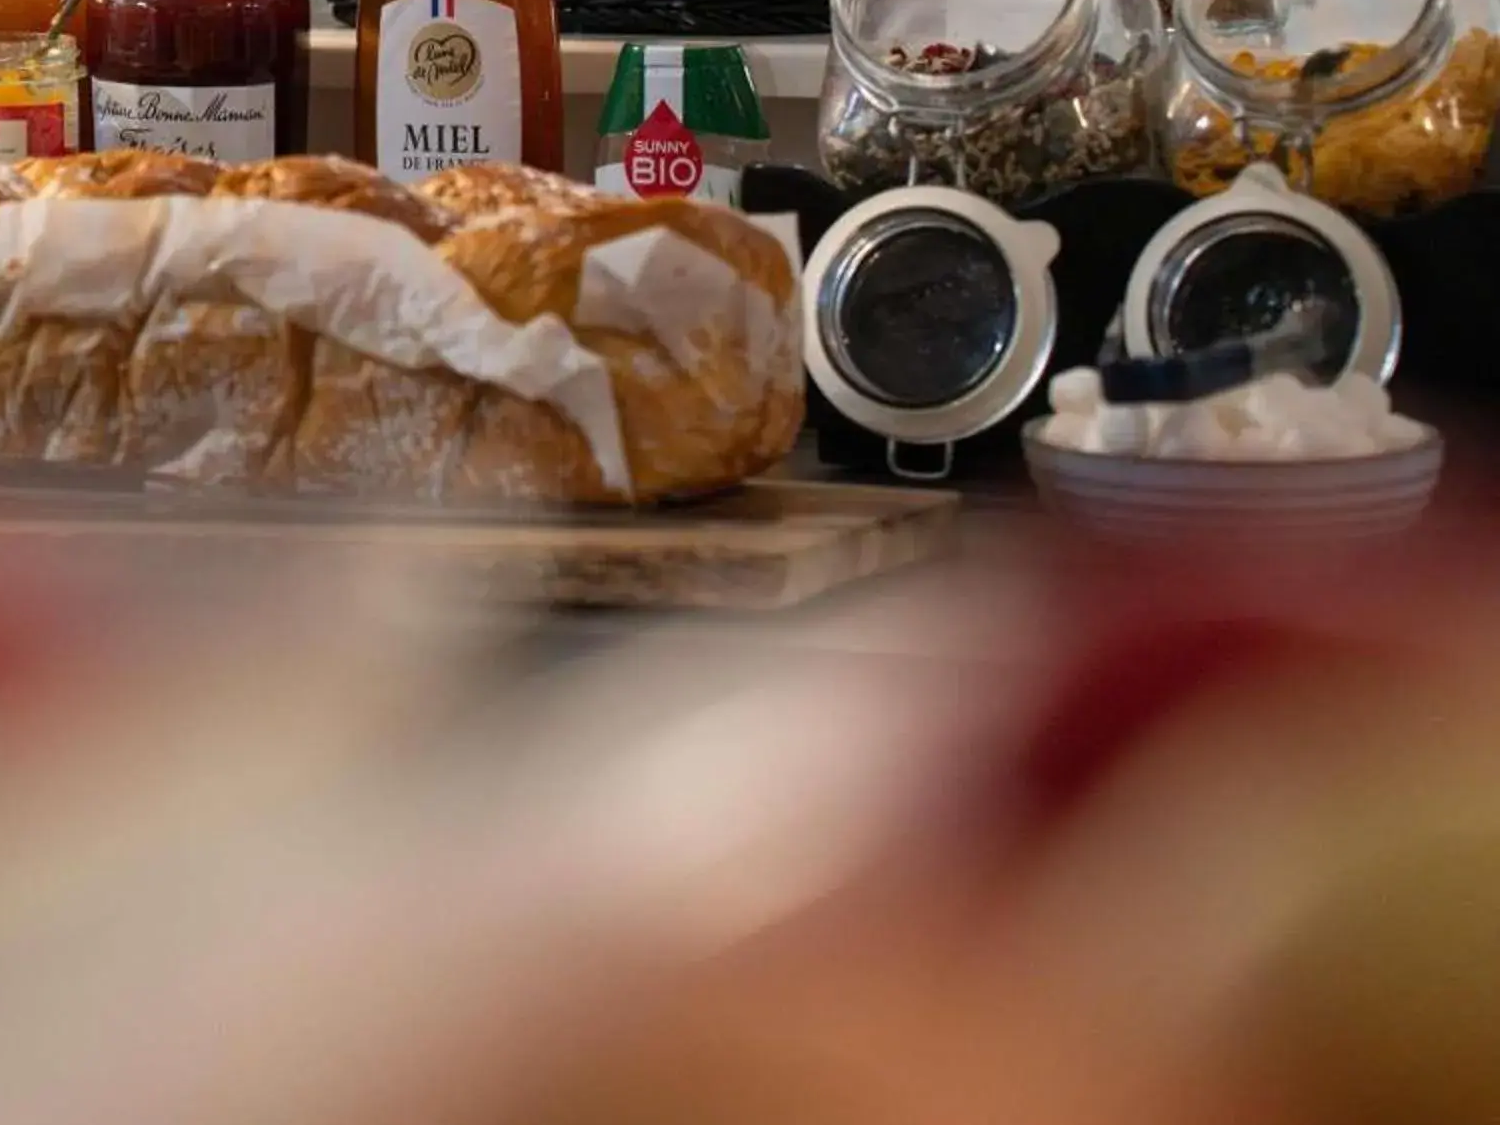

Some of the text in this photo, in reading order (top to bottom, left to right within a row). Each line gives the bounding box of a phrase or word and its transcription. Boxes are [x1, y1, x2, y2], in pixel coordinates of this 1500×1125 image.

[402, 123, 491, 154] MIEL
[632, 139, 691, 155] SUNNY
[402, 156, 423, 171] DE
[631, 156, 697, 187] BIO
